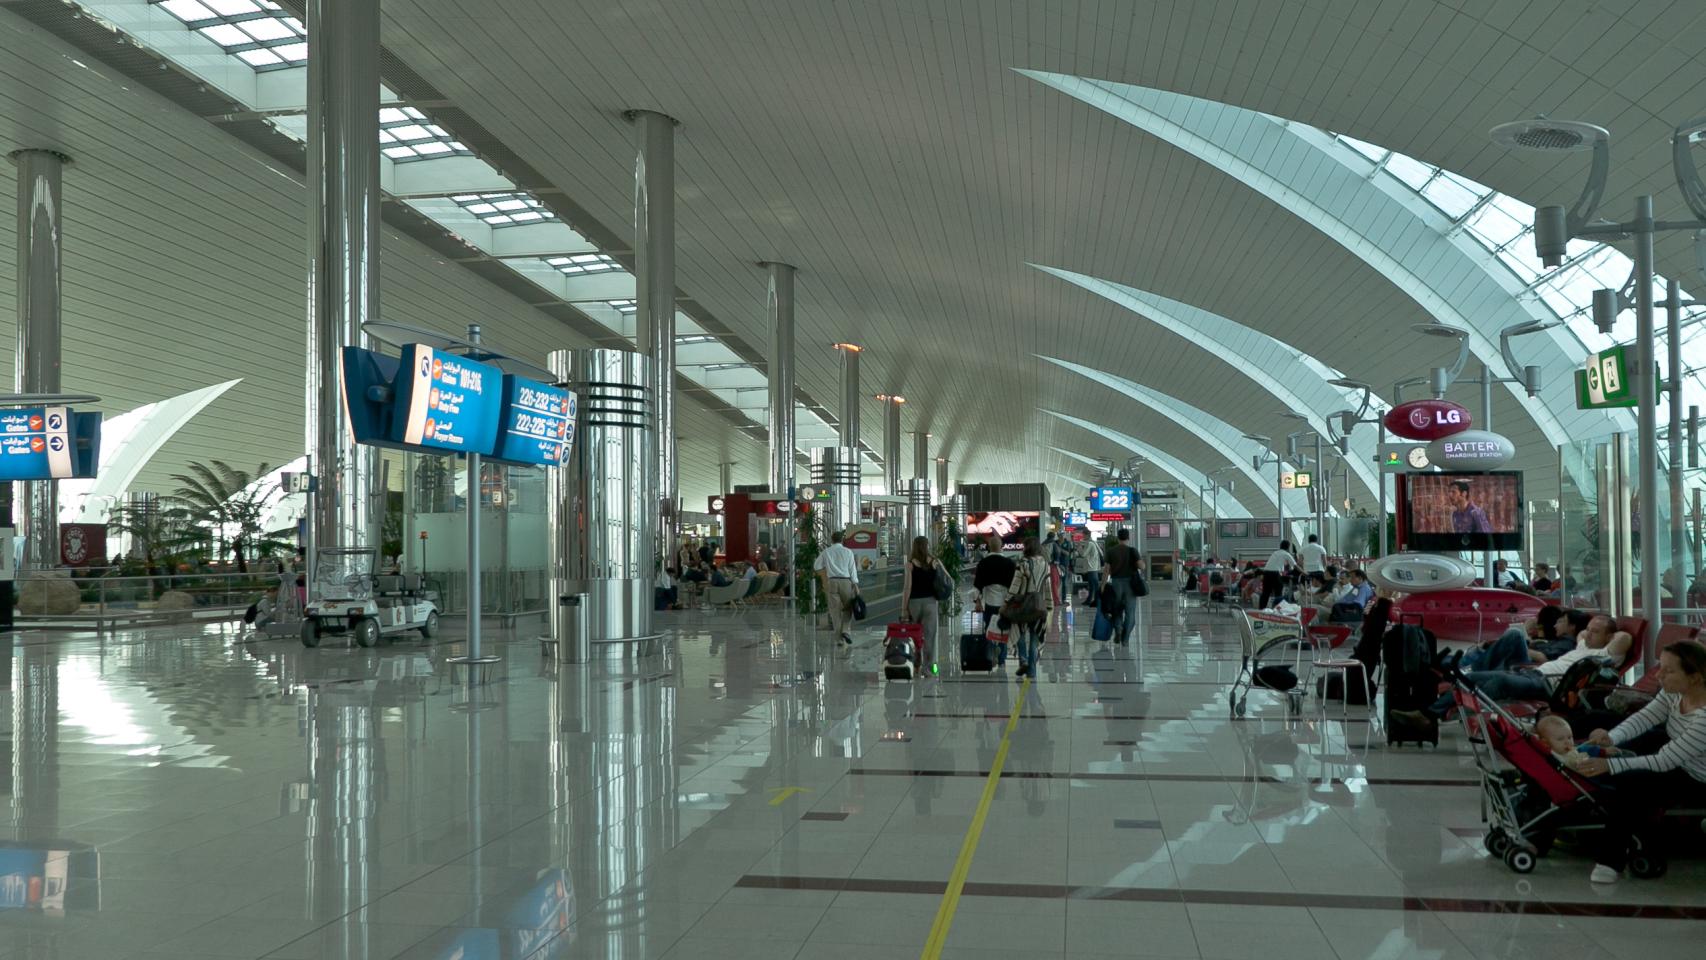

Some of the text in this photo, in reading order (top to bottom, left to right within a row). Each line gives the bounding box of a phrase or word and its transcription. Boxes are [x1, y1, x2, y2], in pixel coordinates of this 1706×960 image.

[442, 372, 456, 386] Gates
[520, 387, 549, 410] 226-232
[550, 404, 560, 412] Gates
[1436, 410, 1460, 424] LG
[6, 424, 28, 432] Gates
[516, 414, 546, 435] 222-225
[546, 428, 556, 437] Gates
[8, 446, 30, 454] Gates
[1444, 442, 1501, 452] BATTERY
[1102, 496, 1128, 508] 222
